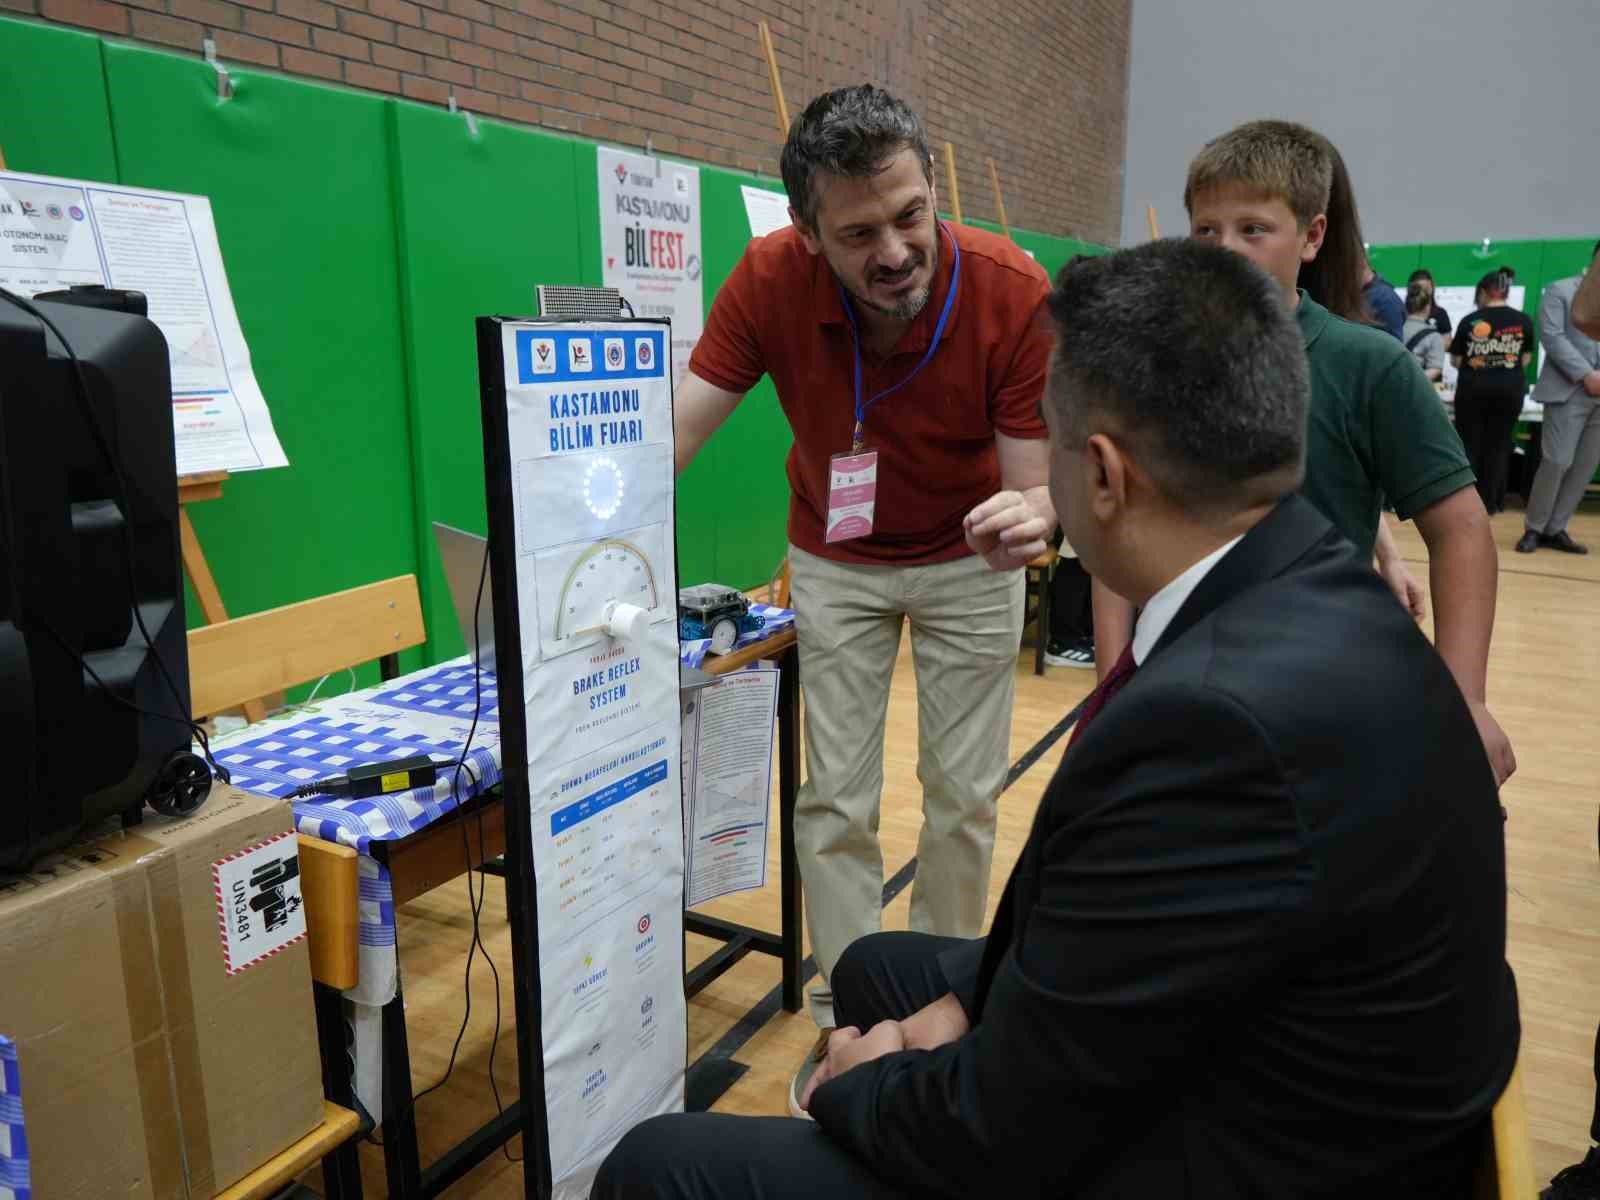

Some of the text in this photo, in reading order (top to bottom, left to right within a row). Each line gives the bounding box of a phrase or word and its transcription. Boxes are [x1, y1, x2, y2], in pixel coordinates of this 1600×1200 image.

[625, 221, 684, 270] BİLFEST
[550, 388, 640, 418] KASTAMONU
[549, 418, 642, 451] BİLİM FUARI
[573, 657, 641, 695] BRAKE REFLEX
[590, 684, 626, 710] SYSTEM
[232, 879, 252, 943] UN3481
